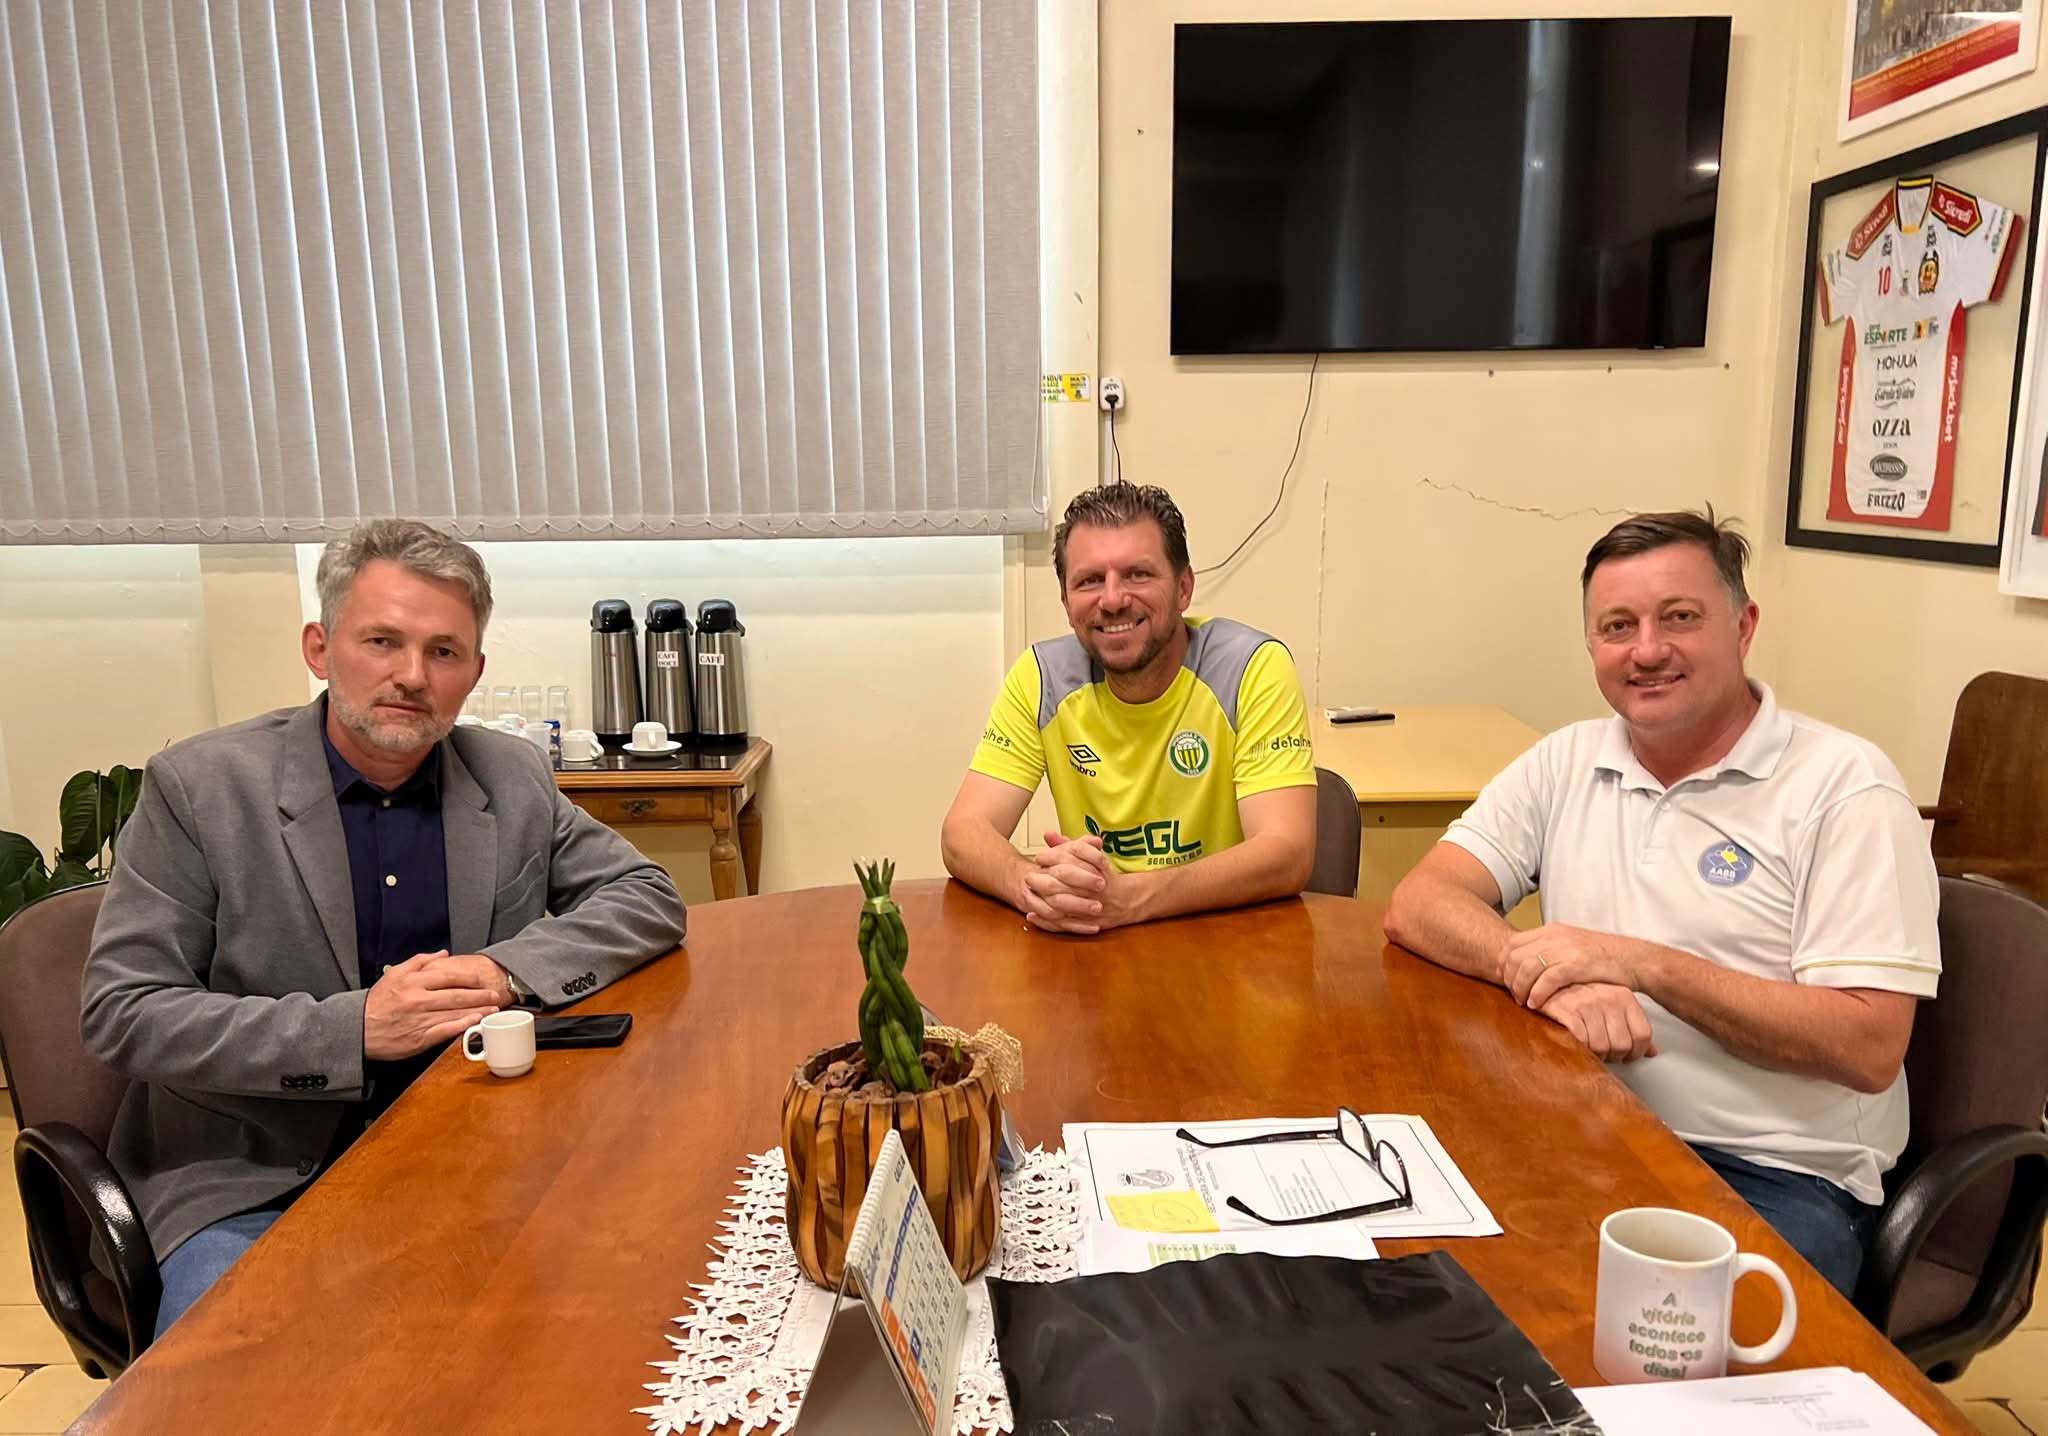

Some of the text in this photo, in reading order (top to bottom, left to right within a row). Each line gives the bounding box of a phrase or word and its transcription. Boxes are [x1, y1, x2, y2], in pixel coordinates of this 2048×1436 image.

[1878, 265, 1891, 296] 10
[1867, 492, 1905, 511] FRIZZO
[1662, 1292, 1677, 1307] A
[1641, 1307, 1696, 1326] vitória
[1628, 1321, 1706, 1343] acontece
[1629, 1339, 1703, 1361] todos os
[1643, 1361, 1688, 1379] dias!
